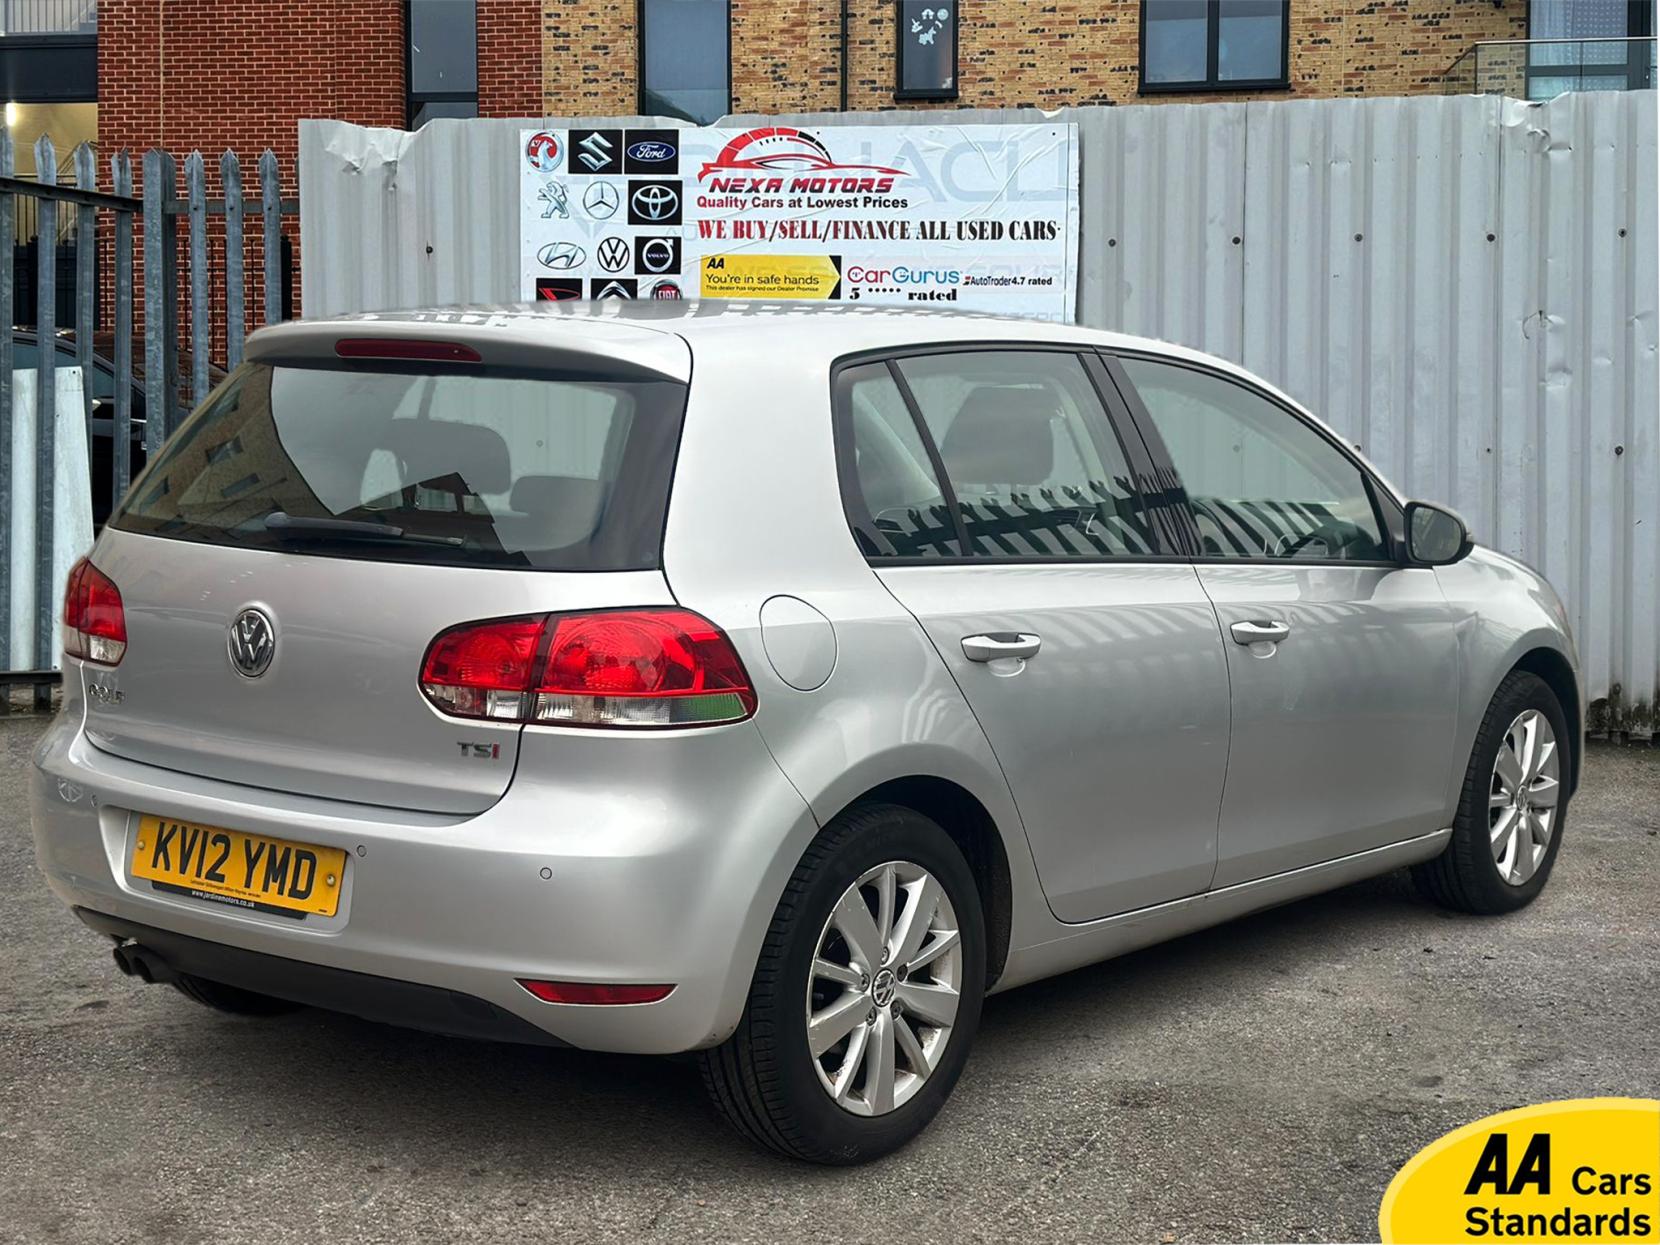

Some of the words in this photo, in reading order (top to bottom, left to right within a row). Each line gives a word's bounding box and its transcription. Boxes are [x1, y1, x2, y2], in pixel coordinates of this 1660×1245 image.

[636, 145, 666, 158] Ford
[709, 178, 783, 193] NEXA
[789, 178, 894, 193] MOTORS
[697, 196, 747, 210] Quality
[752, 196, 784, 208] Cars
[788, 197, 802, 208] at
[807, 196, 858, 208] Lowest
[863, 196, 908, 208] Prices
[697, 220, 726, 239] WE
[733, 219, 910, 242] BUY/SELL/FINANCE
[916, 221, 950, 240] ALL
[957, 221, 1003, 240] USED
[1009, 220, 1057, 240] CARS
[707, 258, 725, 269] AA
[706, 273, 741, 284] You're
[744, 275, 754, 284] in
[757, 274, 781, 285] safe
[784, 275, 819, 285] hands
[847, 266, 960, 283] CarGurus
[1028, 277, 1053, 285] rated
[849, 287, 860, 300] 5
[908, 288, 957, 300] rated
[152, 821, 231, 883] KV12
[243, 838, 317, 899] YMD
